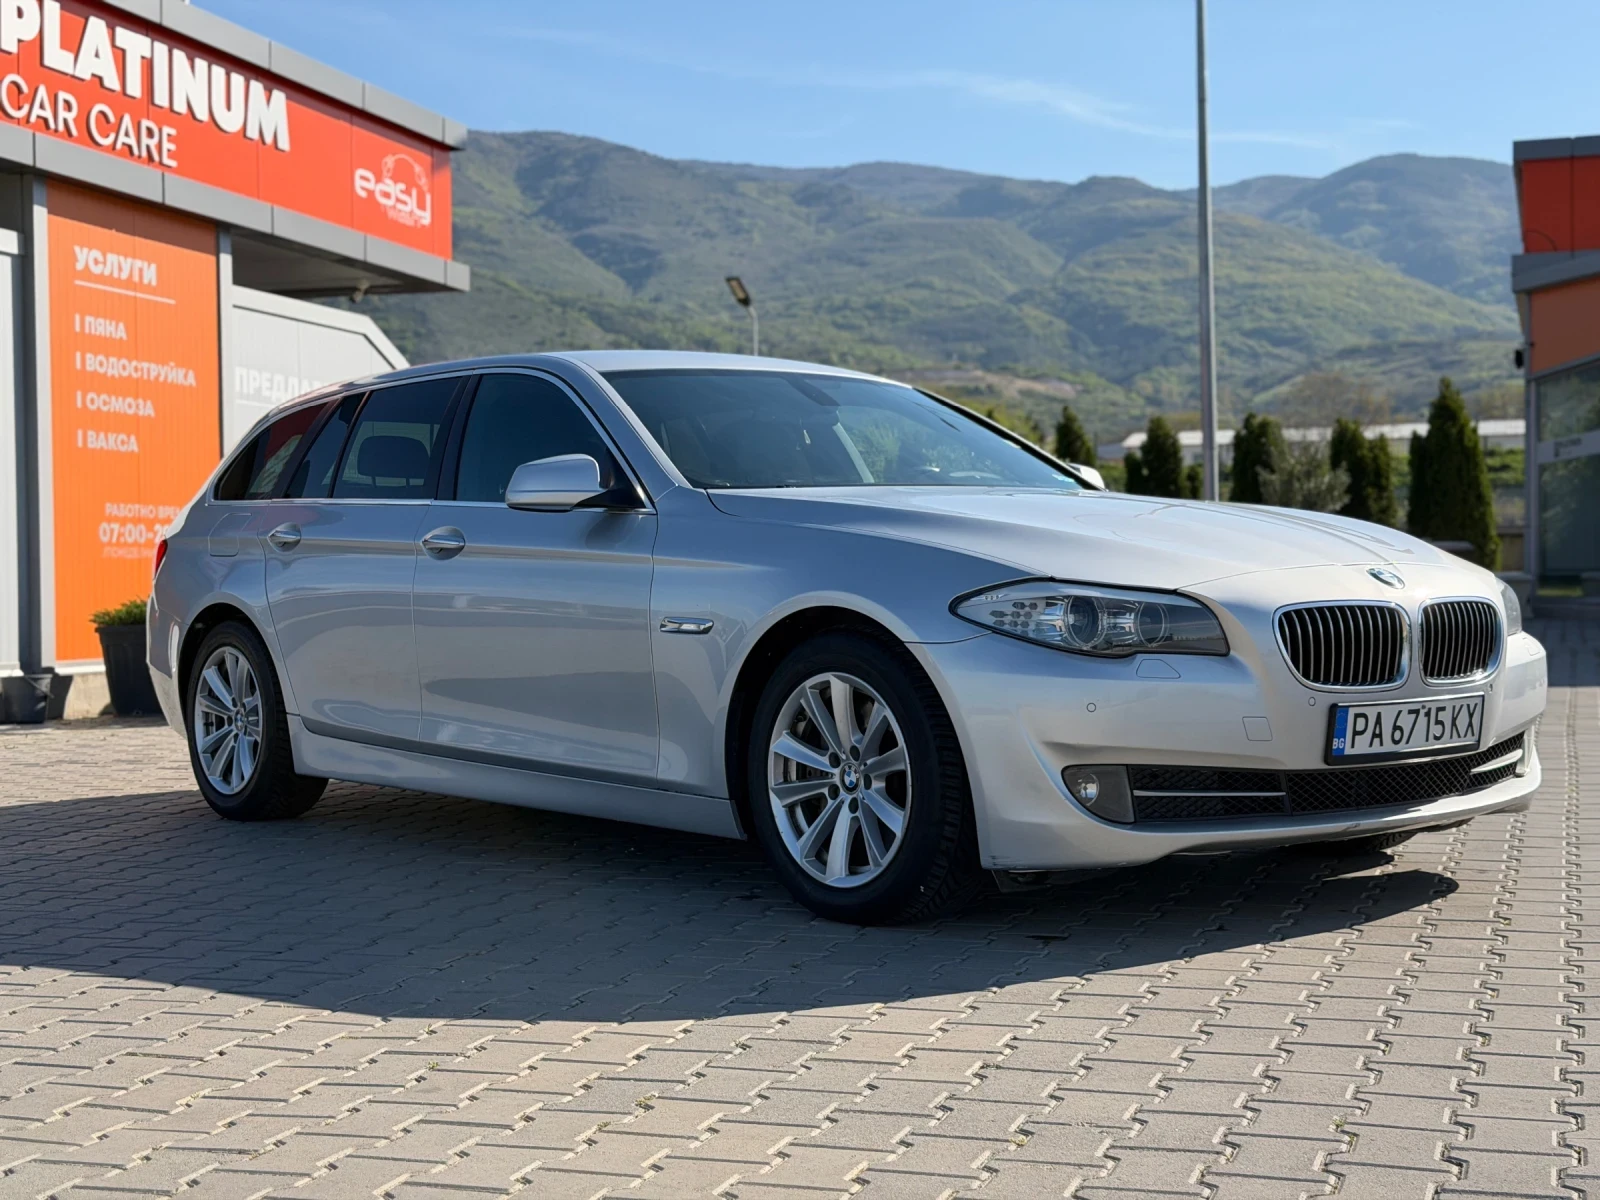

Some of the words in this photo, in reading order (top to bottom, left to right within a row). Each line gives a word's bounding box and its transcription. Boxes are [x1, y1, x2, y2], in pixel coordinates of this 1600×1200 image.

[0, 0, 290, 152] PLATINUM
[1, 73, 79, 137] CAR
[87, 102, 178, 168] CARE
[354, 167, 431, 226] easy
[73, 245, 157, 286] УСЛУГИ
[84, 314, 127, 340] ПЯНА
[85, 353, 196, 386] ВОДОСТРУЙКА
[86, 391, 155, 418] ОСМОЗА
[87, 430, 138, 453] ВАКСА
[1332, 737, 1344, 749] BG
